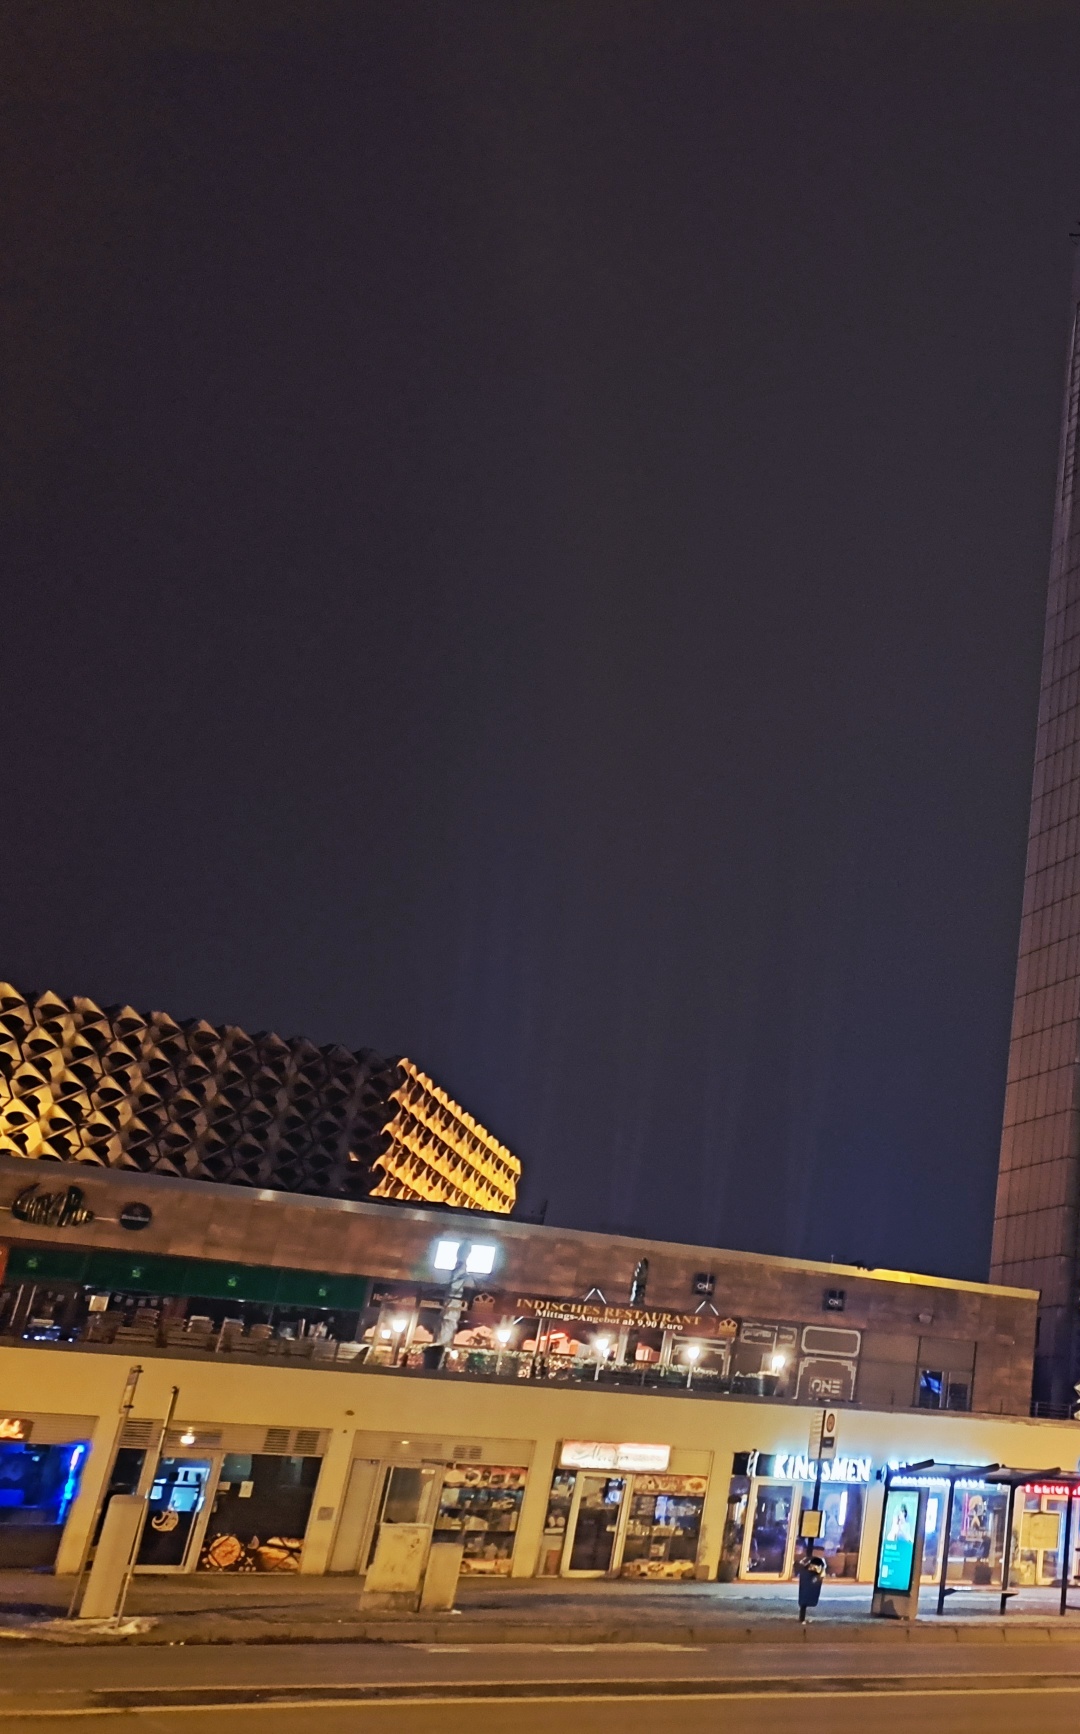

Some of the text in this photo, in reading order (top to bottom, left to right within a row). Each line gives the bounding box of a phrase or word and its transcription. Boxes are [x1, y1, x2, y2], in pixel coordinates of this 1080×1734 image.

[516, 1298, 702, 1325] INDISCHES RESTAURANT
[535, 1308, 684, 1331] Mittags-Angebot ab 9,90 Euro
[811, 1379, 841, 1395] ONE
